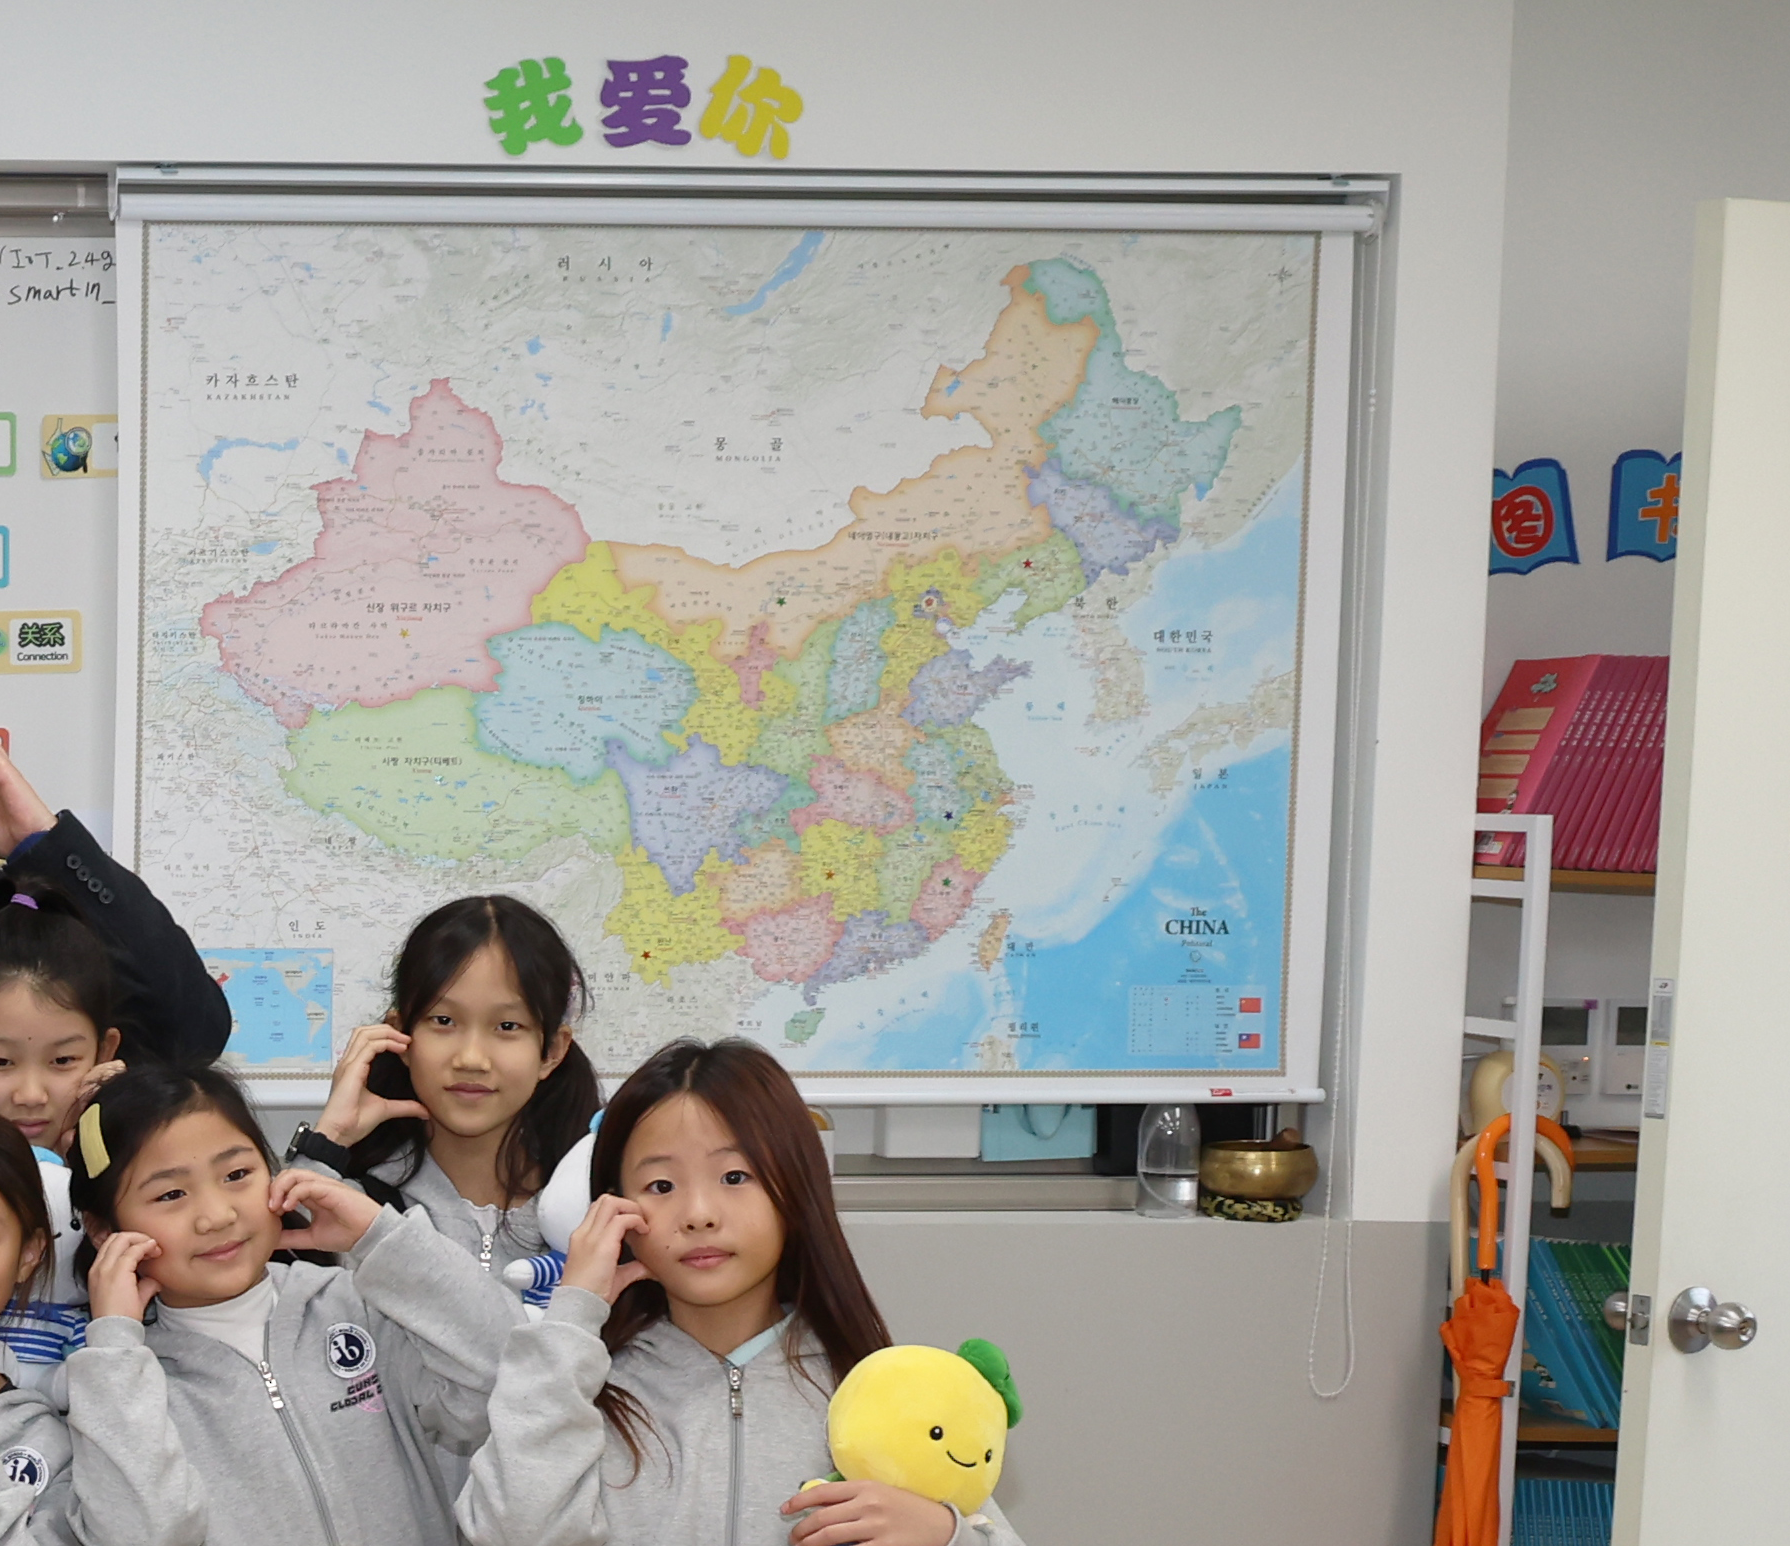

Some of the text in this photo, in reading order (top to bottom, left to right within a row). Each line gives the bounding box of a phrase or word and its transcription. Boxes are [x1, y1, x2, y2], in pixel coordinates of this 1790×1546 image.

[483, 54, 804, 160] 我爱你
[206, 372, 300, 389] 카자흐스탄
[714, 436, 783, 452] 몽골
[18, 622, 66, 648] 关系
[1153, 629, 1213, 644] 대한민국
[17, 650, 69, 661] Connection
[1191, 907, 1207, 916] The
[1165, 919, 1230, 935] CHINA
